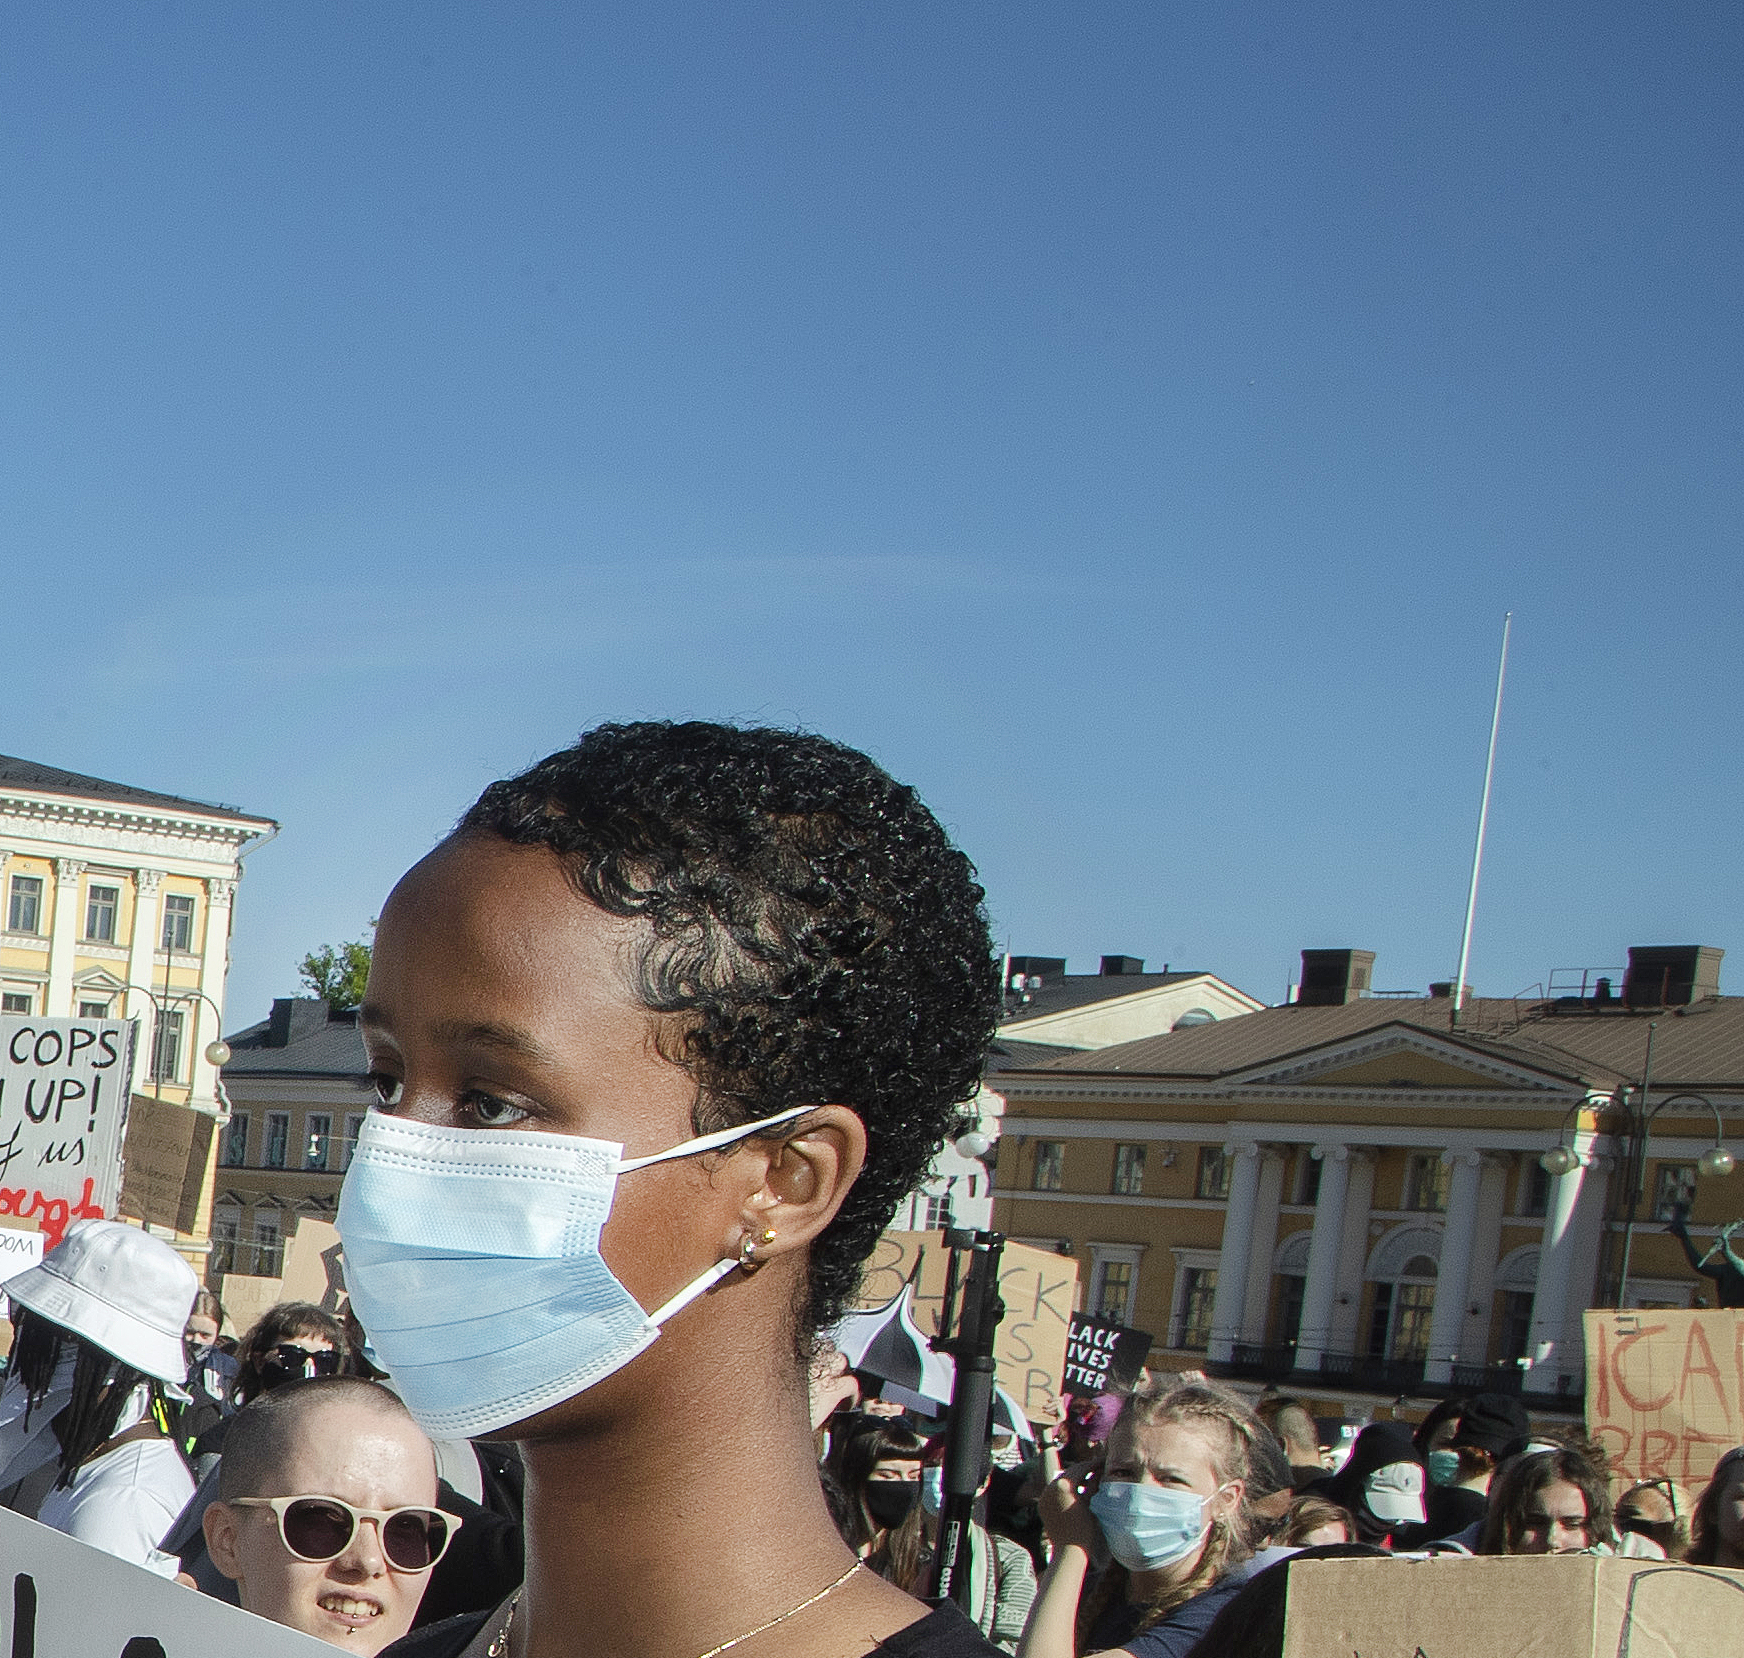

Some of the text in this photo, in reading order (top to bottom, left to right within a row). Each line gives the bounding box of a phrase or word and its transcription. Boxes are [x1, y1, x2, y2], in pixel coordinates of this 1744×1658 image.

[10, 1027, 119, 1069] COPS
[25, 1074, 101, 1132] UP!
[38, 1137, 85, 1167] us
[1068, 1320, 1121, 1350] LACK
[1068, 1342, 1113, 1369] IVES
[1065, 1365, 1108, 1390] TTER
